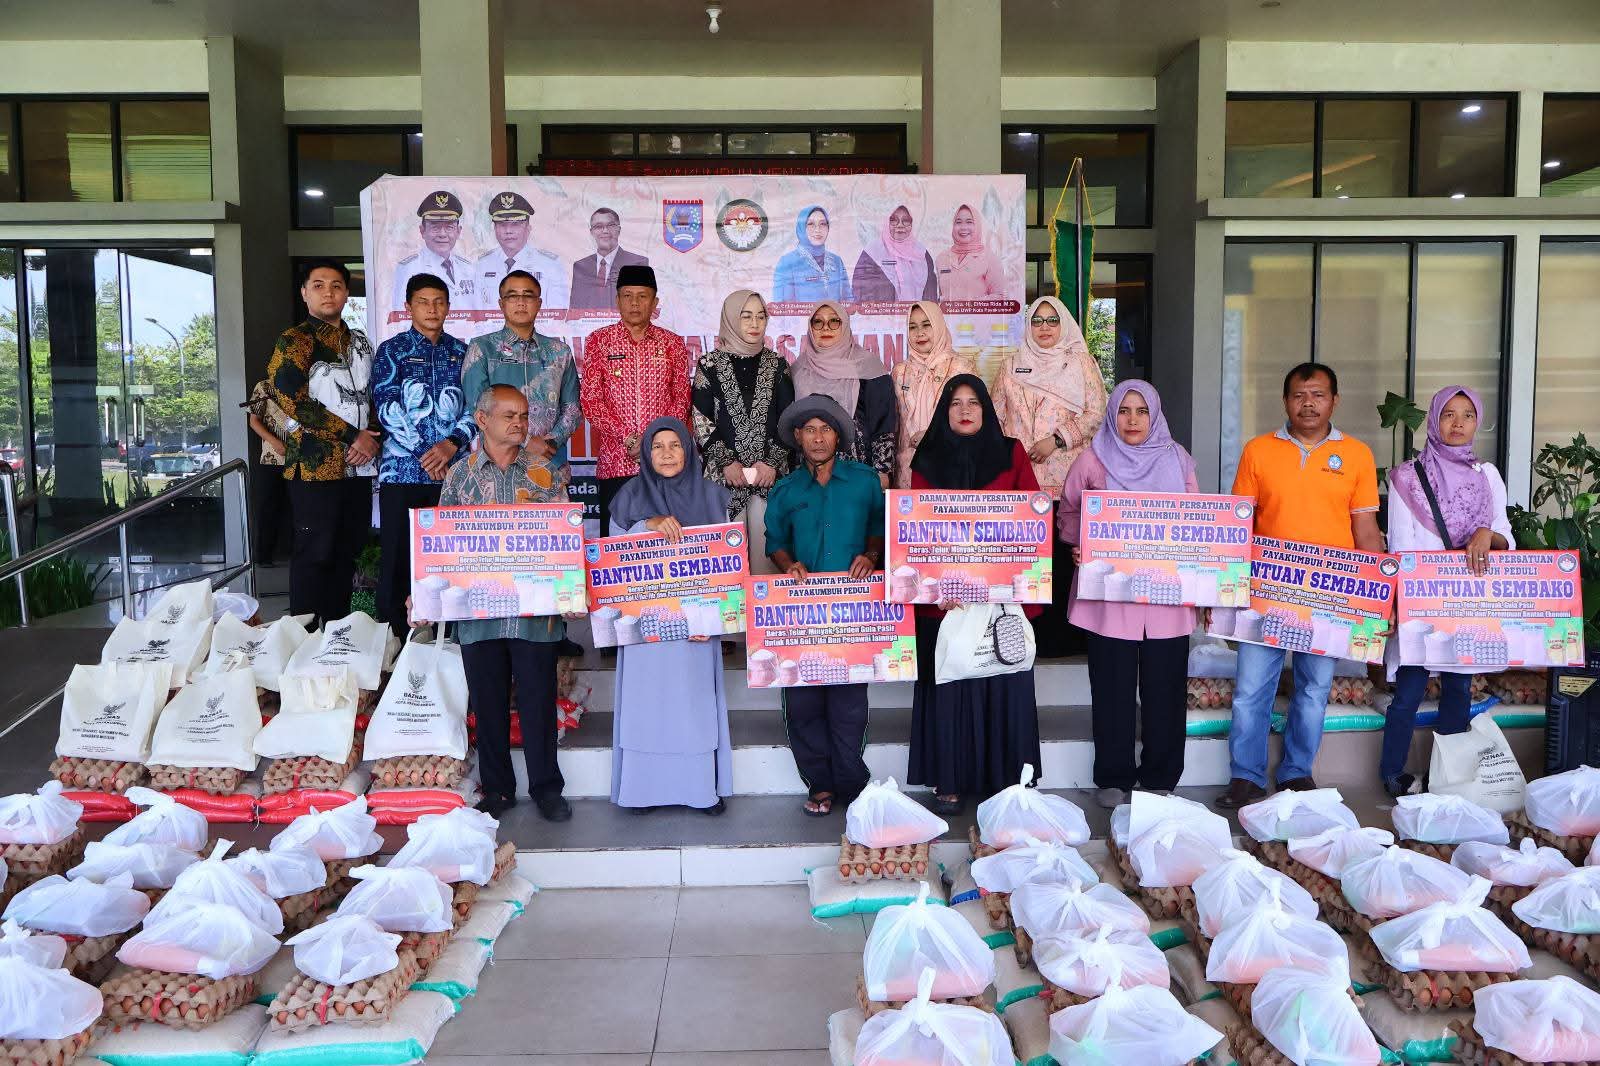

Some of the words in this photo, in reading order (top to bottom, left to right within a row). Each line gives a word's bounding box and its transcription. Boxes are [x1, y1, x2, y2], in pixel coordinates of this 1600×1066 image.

[1141, 500, 1177, 509] WANITA
[1180, 502, 1231, 510] PERSATUAN
[440, 511, 471, 519] DARMA
[475, 511, 509, 519] WANITA
[512, 510, 563, 519] PERSATUAN
[1121, 510, 1181, 520] PAYAKUMBUH
[1184, 513, 1216, 522] PEDULI
[455, 522, 514, 530] PAYAKUMBUH
[898, 520, 970, 544] BANTUAN
[974, 520, 1047, 543] SEMBAKO
[1089, 522, 1166, 542] BANTUAN
[1171, 526, 1248, 544] SEMBAKO
[422, 535, 500, 552] BANTUAN
[506, 534, 581, 552] SEMBAKO
[604, 542, 633, 552] DARMA
[636, 538, 670, 549] WANITA
[677, 532, 722, 546] ERSATUAN
[620, 550, 676, 562] PAYAKUMBUH
[678, 546, 709, 556] PEDULI
[984, 555, 1012, 563] Pegawai
[1284, 542, 1320, 556] WANITA
[1323, 546, 1377, 565] PERSATUAN
[1422, 555, 1454, 563] DARMA
[1499, 555, 1553, 564] PERSATUAN
[1262, 550, 1323, 568] PAYAKUMBUH
[1326, 561, 1360, 574] PEDULI
[591, 563, 664, 586] BANTUAN
[669, 555, 743, 578] SEMBAKO
[1504, 567, 1538, 575] PEDULI
[805, 577, 837, 586] WANITA
[1251, 561, 1306, 585] NTUAN
[1310, 572, 1391, 601] SEMBAKO
[788, 588, 842, 597] PAYAKUMBUH
[844, 586, 870, 594] PEDULI
[1404, 580, 1486, 598] BANTUAN
[1492, 580, 1575, 598] SEMBAKO
[754, 603, 828, 627] BANTUAN
[831, 601, 905, 623] SEMBAKO
[842, 636, 871, 644] Pegawai
[1480, 752, 1504, 762] AZNAS
